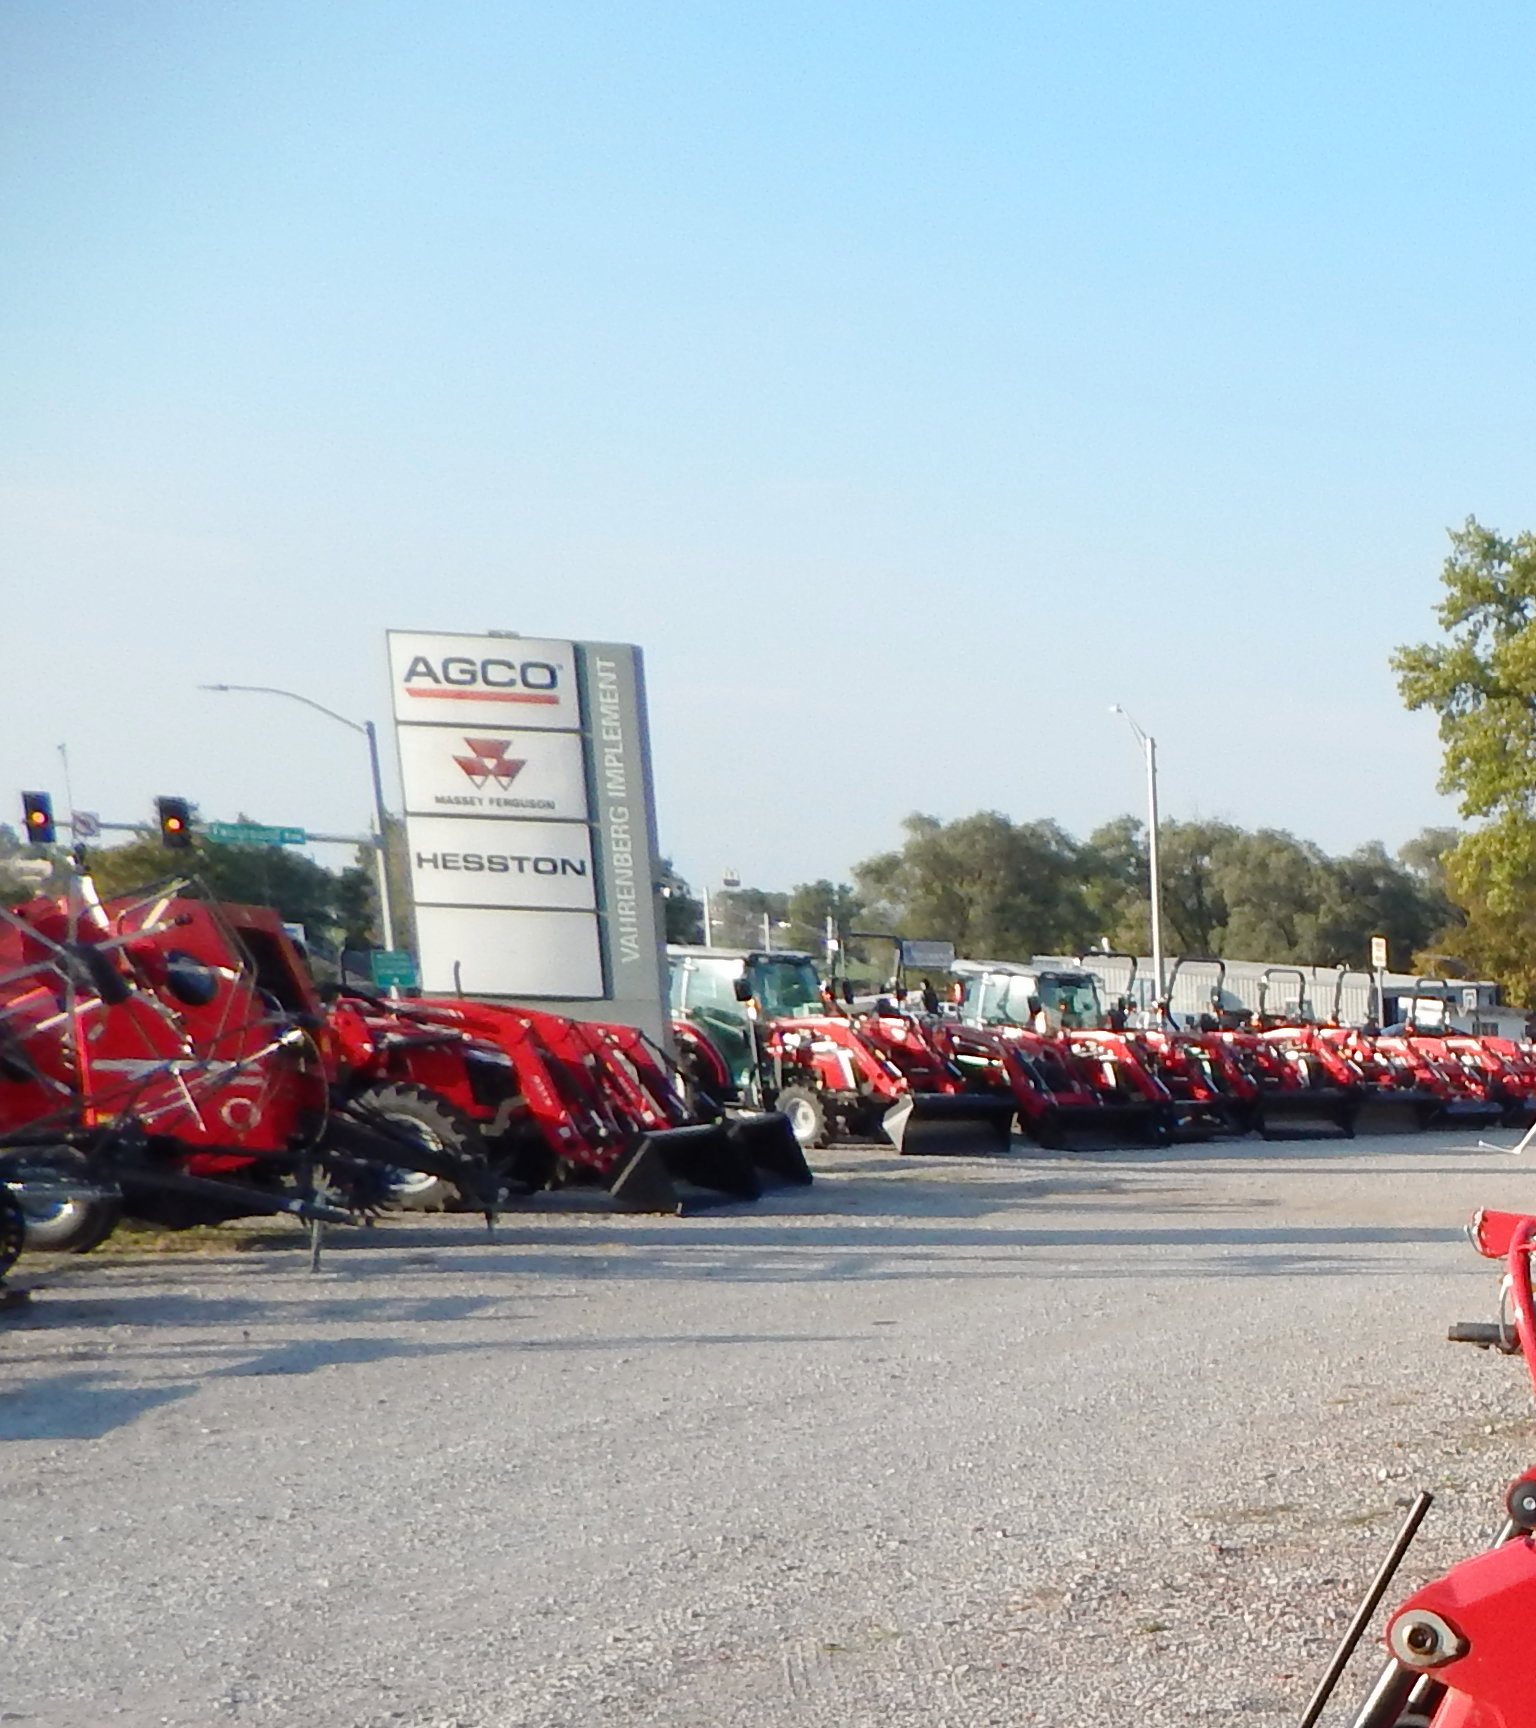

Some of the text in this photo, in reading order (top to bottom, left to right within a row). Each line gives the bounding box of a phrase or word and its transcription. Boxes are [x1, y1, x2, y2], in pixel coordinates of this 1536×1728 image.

[404, 656, 559, 690] AGCO
[434, 794, 556, 812] MASSEY FERGUSON
[595, 657, 641, 965] VAHRENBERG IMPLEMENT
[416, 852, 587, 877] HESSTON
